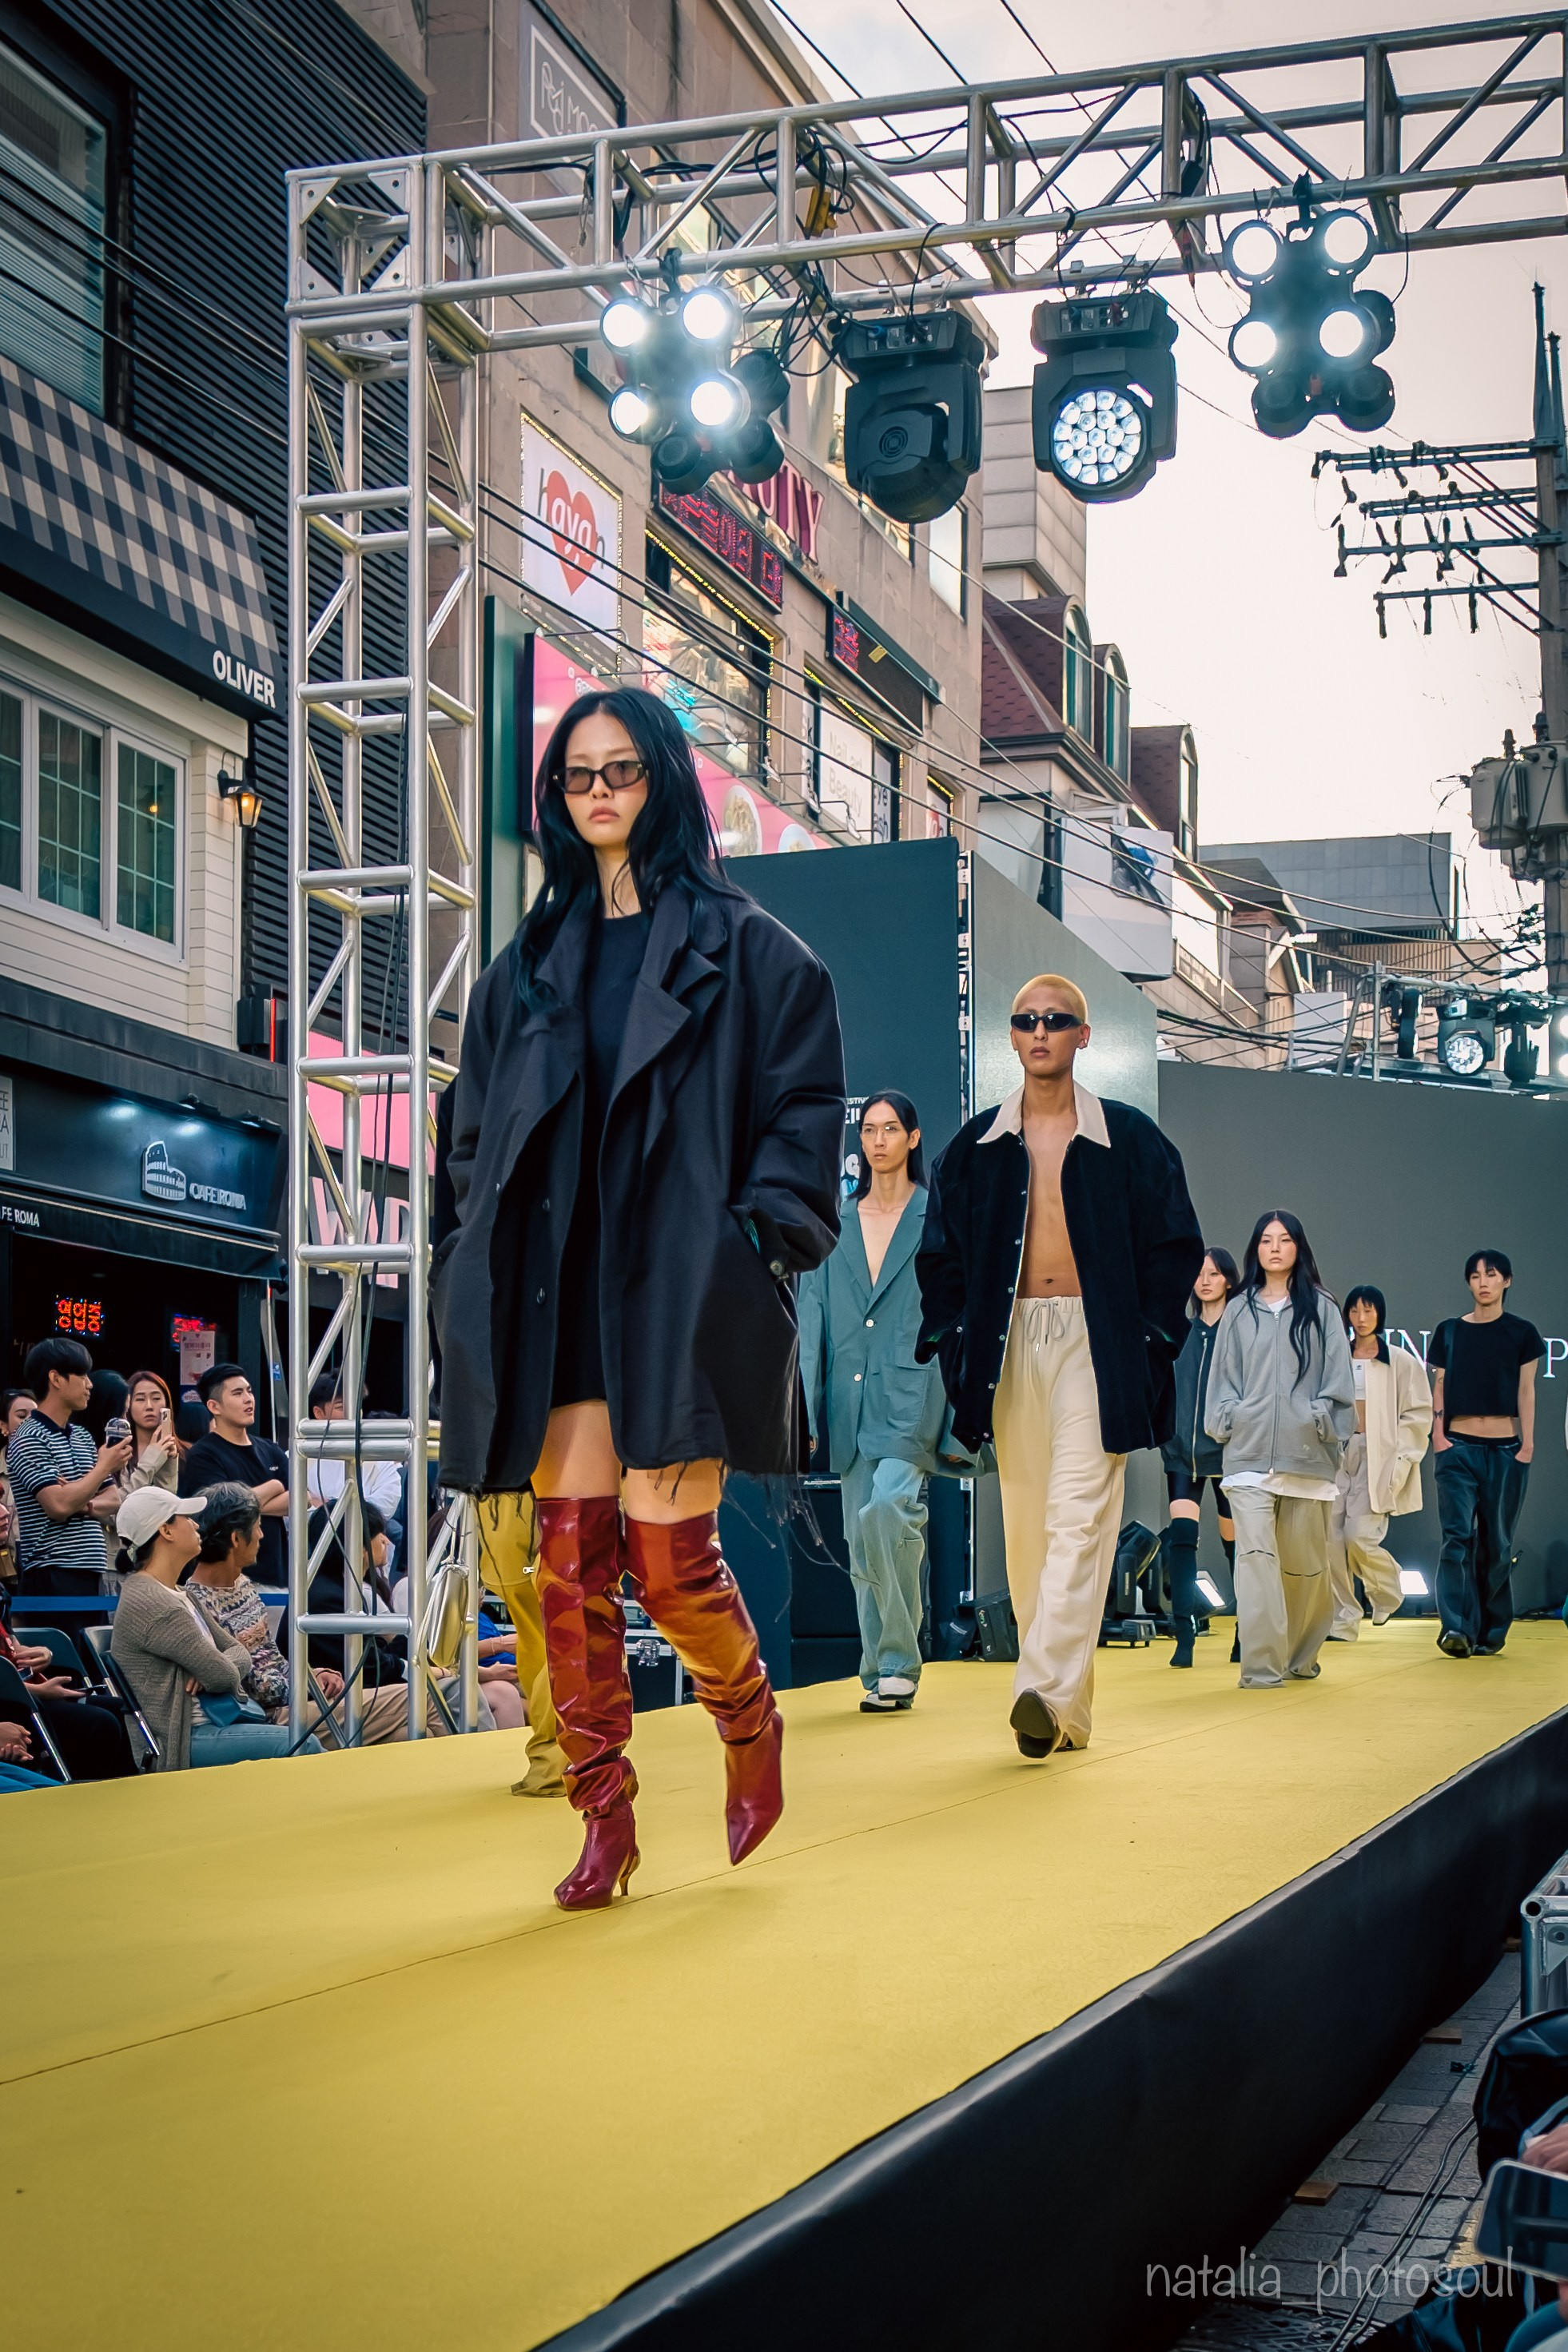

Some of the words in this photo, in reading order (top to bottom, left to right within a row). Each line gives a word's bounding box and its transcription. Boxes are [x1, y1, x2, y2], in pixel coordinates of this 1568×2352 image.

[213, 650, 277, 710] OLIVER
[0, 1205, 13, 1222] FE
[14, 1208, 40, 1228] ROMA
[57, 1299, 102, 1333] 영업중
